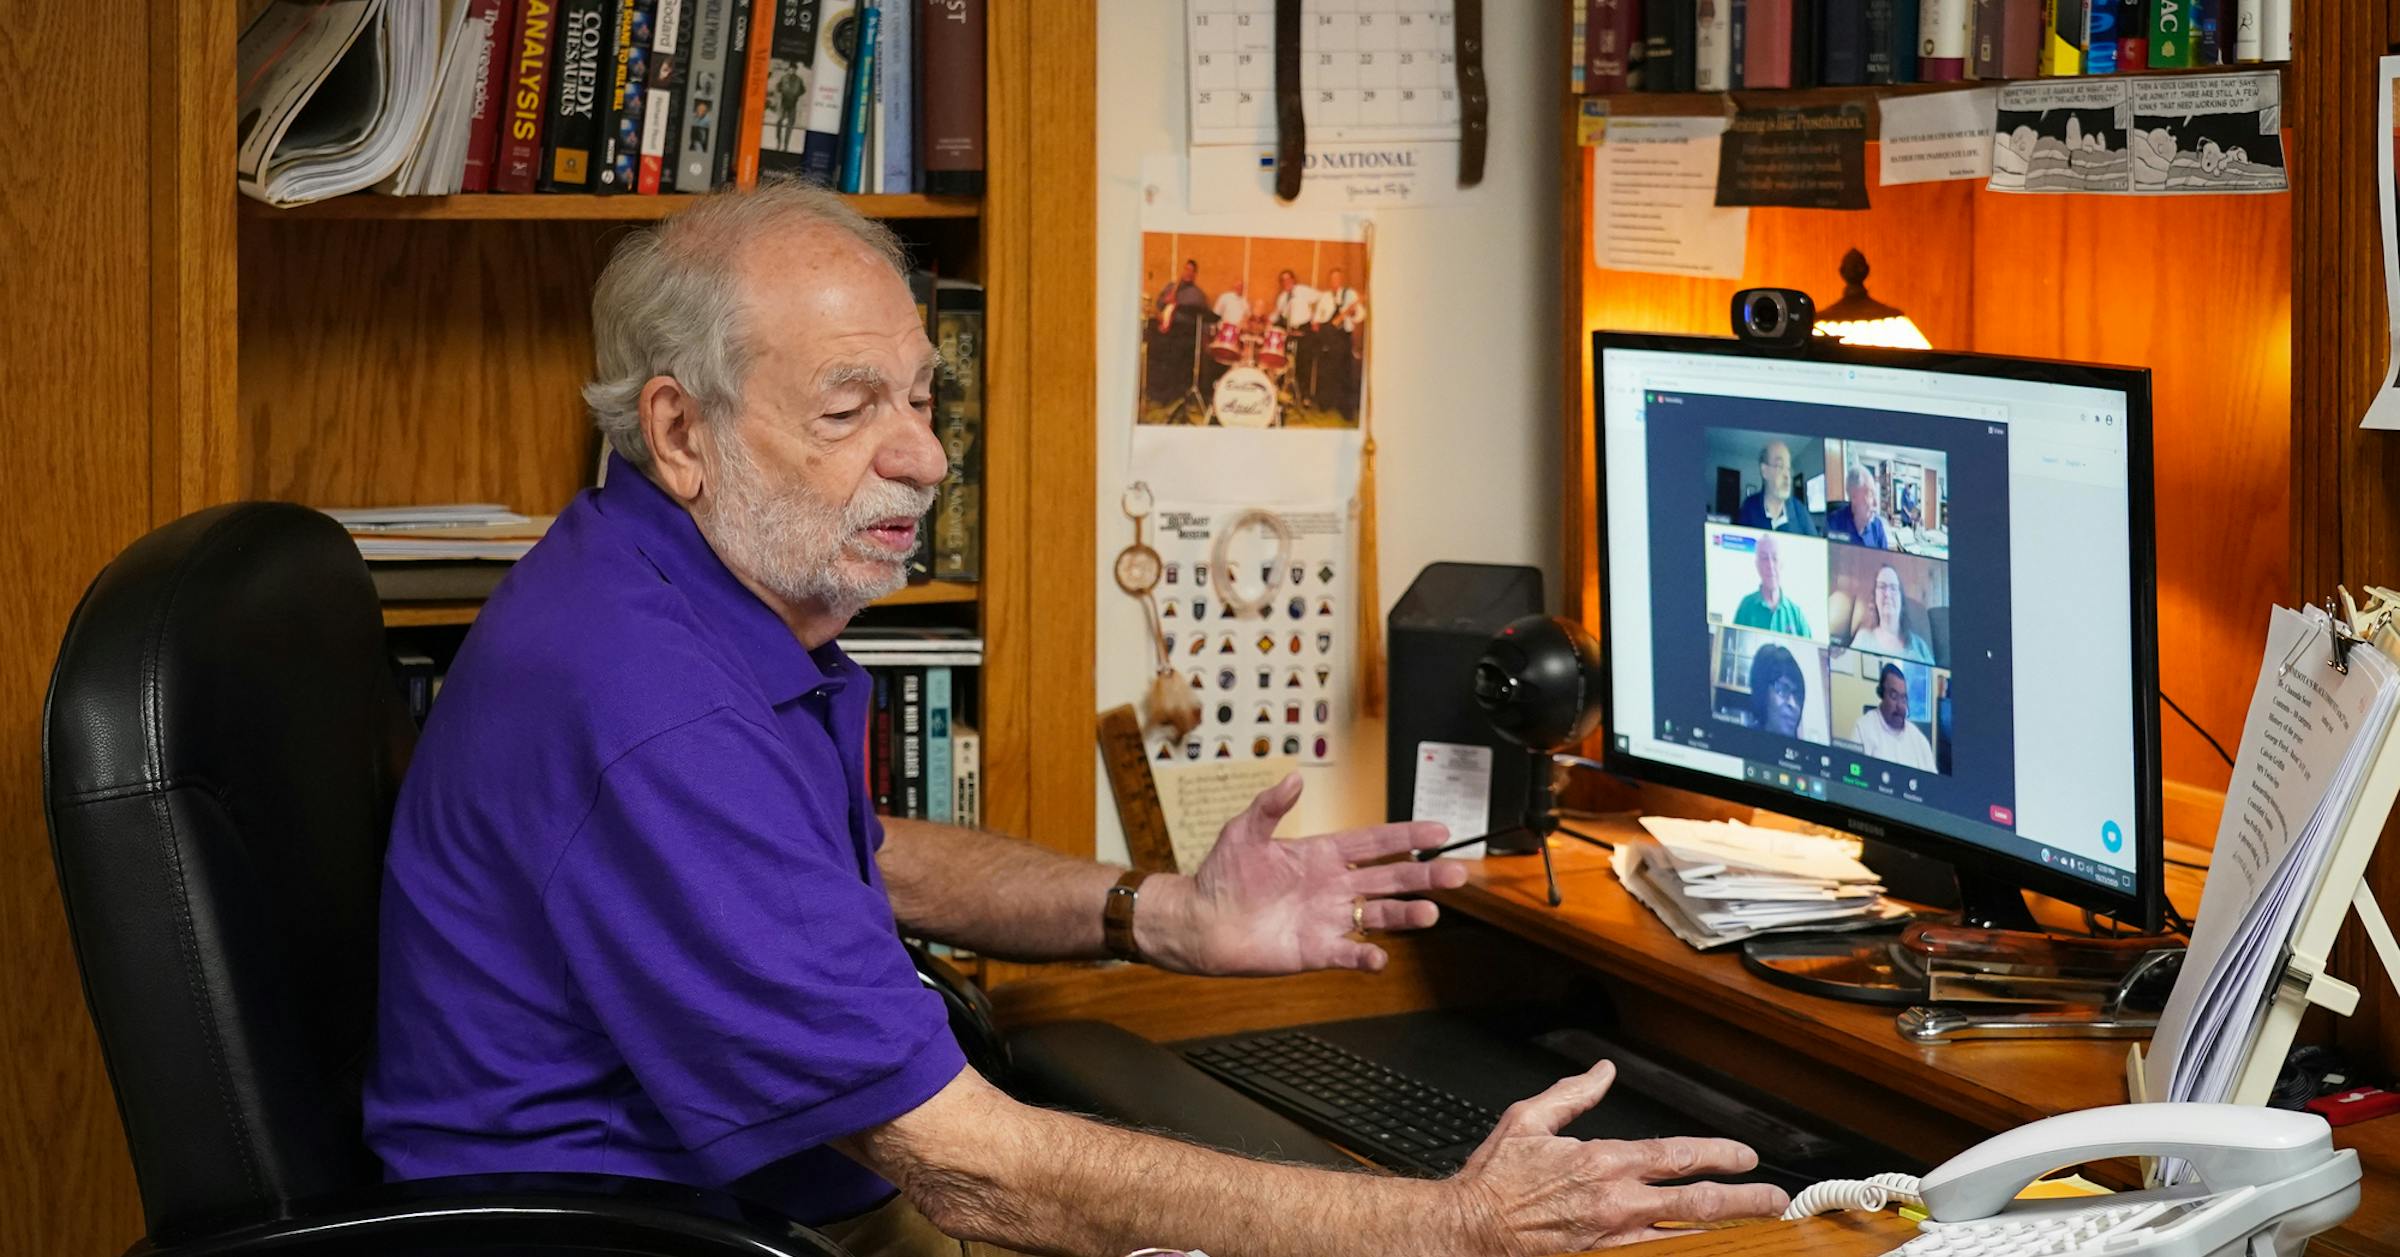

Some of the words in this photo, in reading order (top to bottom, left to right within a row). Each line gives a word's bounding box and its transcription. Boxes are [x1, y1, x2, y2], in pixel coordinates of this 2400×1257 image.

[2159, 0, 2178, 33] AC
[513, 0, 550, 141] ANALYSIS
[560, 9, 584, 118] THESAURUS
[575, 11, 602, 121] COMEDY
[2177, 81, 2198, 89] COMES
[2200, 81, 2207, 89] TO
[2208, 80, 2218, 88] ME
[2220, 79, 2236, 88] THAT
[2215, 88, 2233, 97] STILL
[2235, 88, 2241, 96] A
[2243, 88, 2260, 97] FEW
[2138, 102, 2158, 111] KINKS
[2159, 102, 2175, 110] THAT
[2177, 101, 2193, 110] NEED
[2194, 100, 2228, 109] WORKING
[1322, 150, 1416, 169] NATIONAL
[949, 406, 964, 433] THE
[949, 488, 965, 549] MOVIES
[903, 674, 919, 703] FILM
[903, 704, 919, 733] NOIR
[903, 735, 920, 779] READER
[1847, 817, 1886, 838] SAMSUNG
